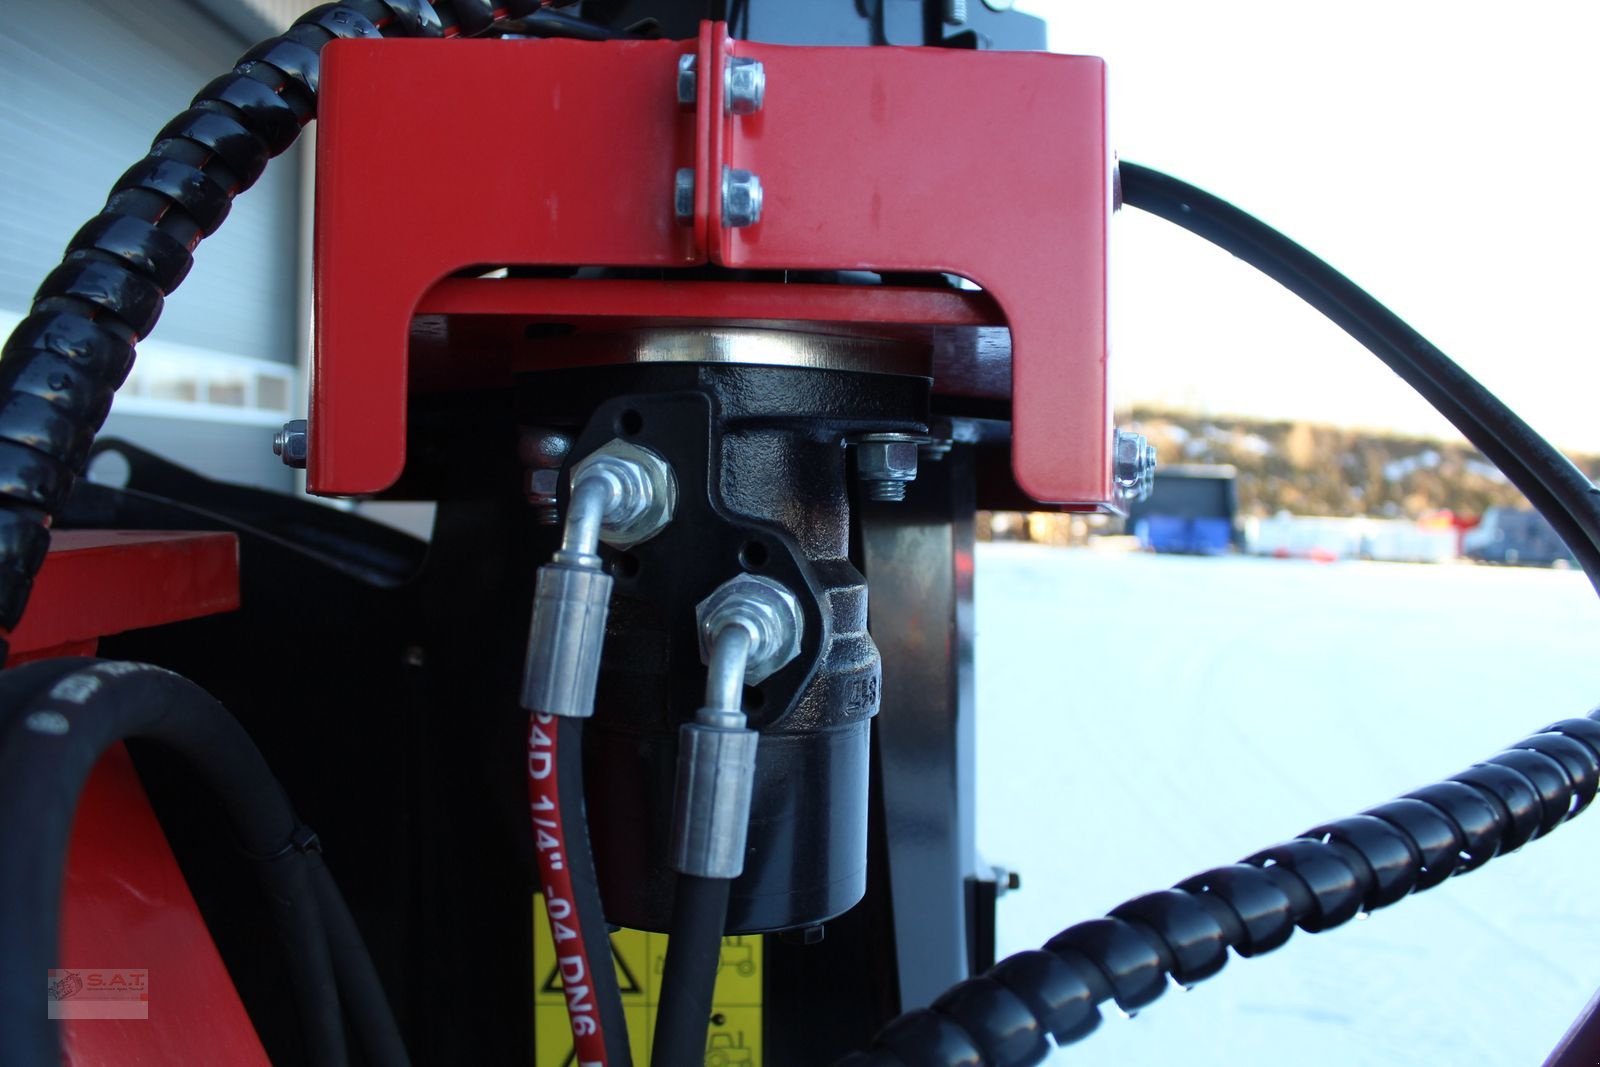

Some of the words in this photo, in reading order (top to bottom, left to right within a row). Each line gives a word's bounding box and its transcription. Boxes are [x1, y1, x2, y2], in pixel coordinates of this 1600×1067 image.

[530, 795, 563, 870] 1/4"
[547, 885, 577, 944] -04
[559, 955, 597, 1036] DN6
